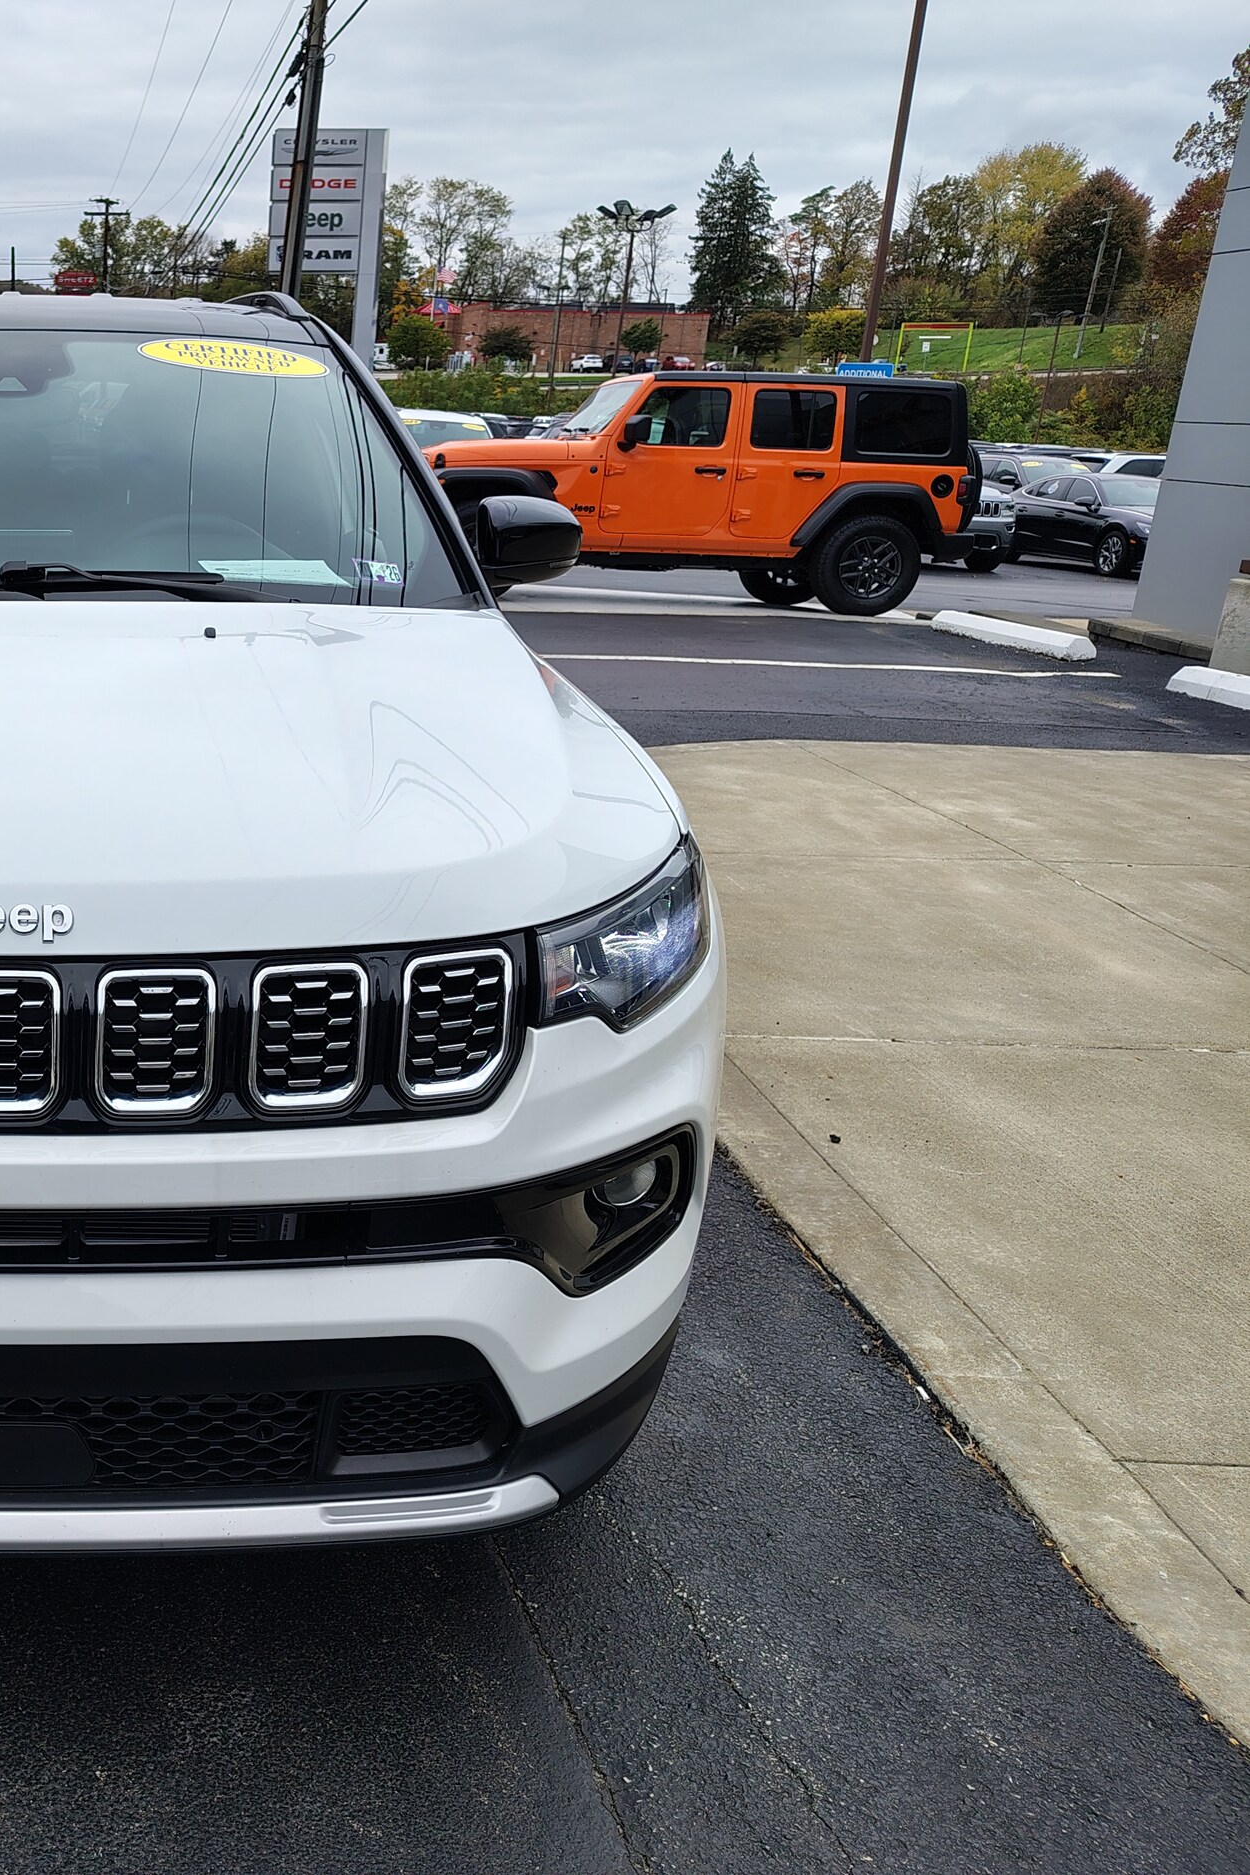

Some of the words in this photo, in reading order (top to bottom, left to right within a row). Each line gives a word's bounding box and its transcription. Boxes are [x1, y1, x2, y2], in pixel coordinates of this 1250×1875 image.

[278, 178, 358, 190] DDGE
[303, 212, 344, 232] eep
[303, 250, 352, 260] RAM
[164, 342, 297, 363] CERTIFIED
[177, 350, 291, 368] PRE-OWNED
[194, 358, 280, 373] VEHICLE
[838, 370, 888, 378] ADDITIONAL
[571, 503, 596, 514] Jeep
[386, 565, 401, 582] 26
